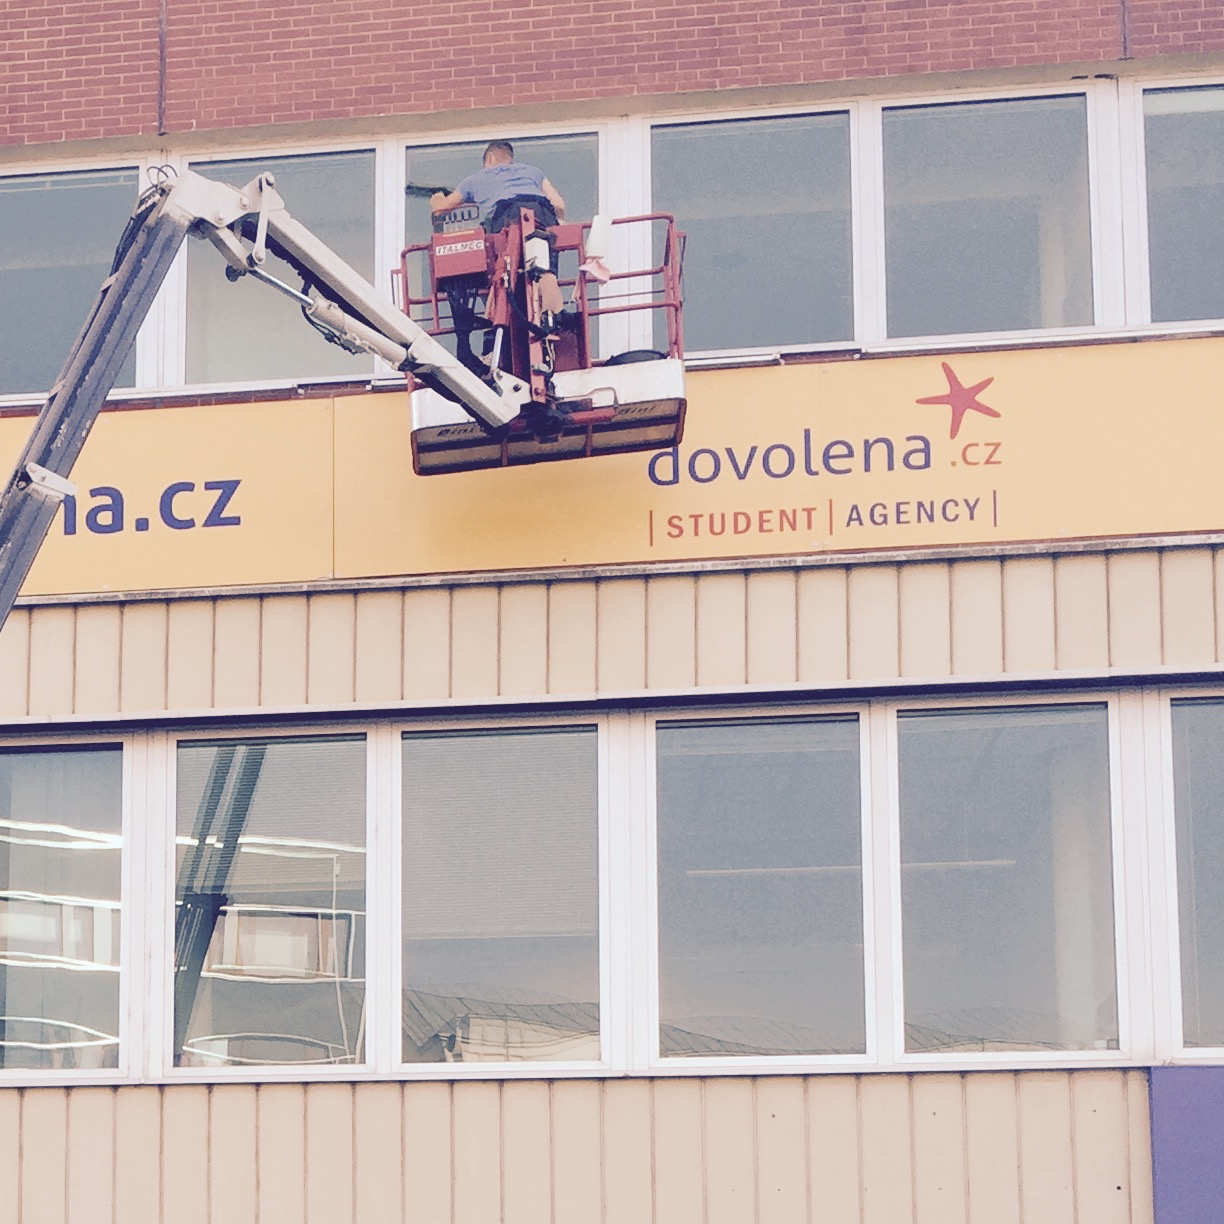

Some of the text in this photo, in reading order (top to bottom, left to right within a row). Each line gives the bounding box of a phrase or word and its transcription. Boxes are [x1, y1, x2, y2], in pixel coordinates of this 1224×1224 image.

[437, 241, 483, 255] ITALMEC
[648, 428, 1003, 486] dovolena .cz
[666, 498, 981, 539] STUDENT AGENCY
